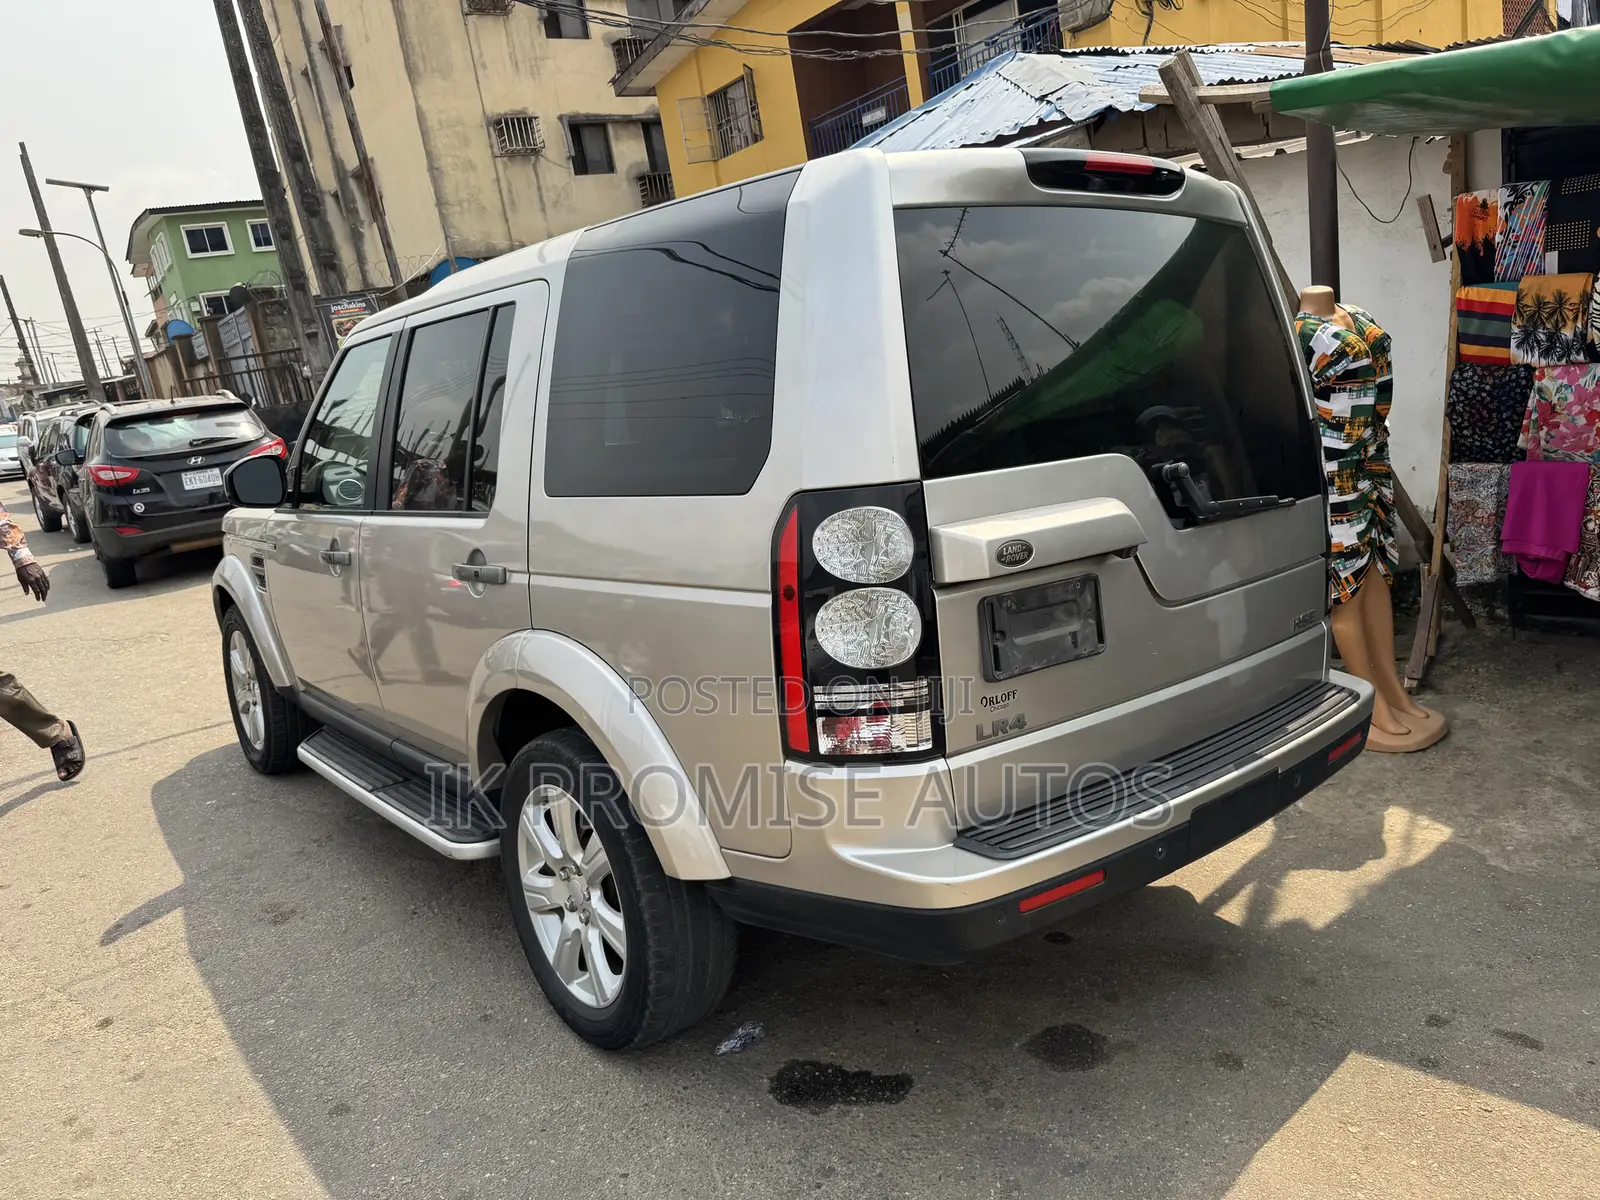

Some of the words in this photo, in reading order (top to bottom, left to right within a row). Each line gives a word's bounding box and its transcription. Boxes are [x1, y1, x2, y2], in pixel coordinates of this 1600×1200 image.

[331, 301, 366, 313] joschakins
[1003, 544, 1022, 555] LAND
[1005, 551, 1029, 563] ROVER
[980, 689, 1018, 708] ORLOFF
[990, 702, 1010, 712] Chicago
[976, 712, 1027, 742] LR4
